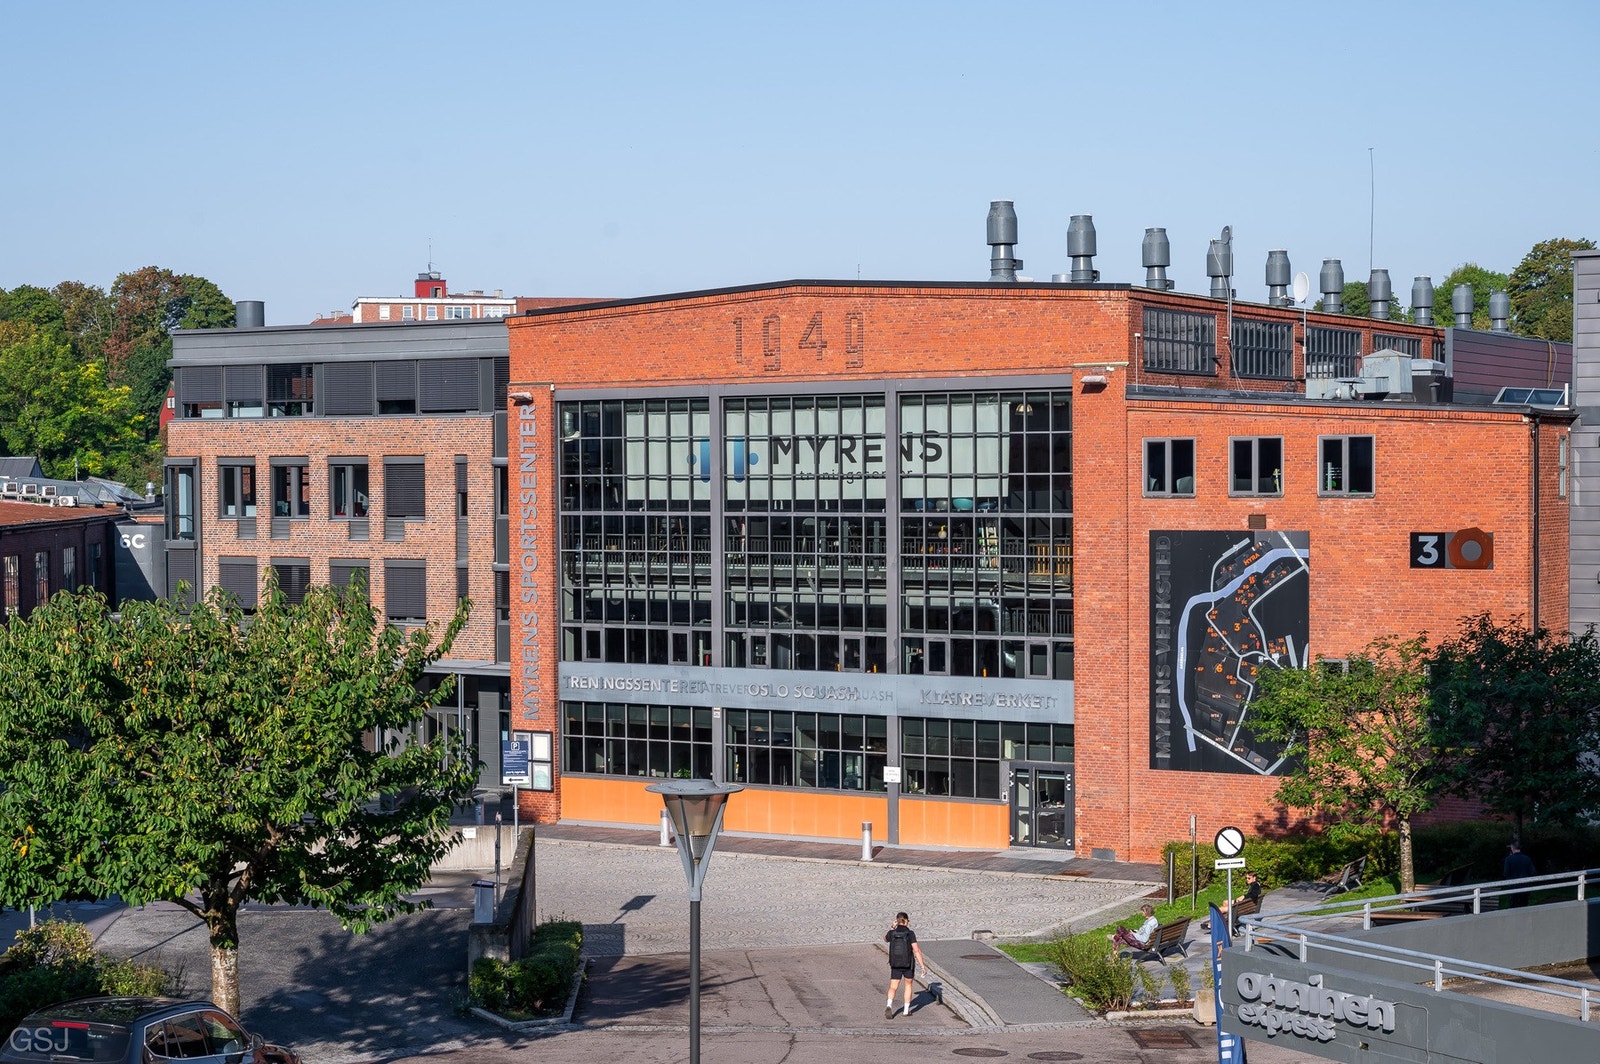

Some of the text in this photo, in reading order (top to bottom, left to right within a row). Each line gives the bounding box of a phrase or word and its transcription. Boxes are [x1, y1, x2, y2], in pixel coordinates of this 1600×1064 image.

[732, 310, 863, 371] 1949
[772, 430, 943, 465] MYRENS
[120, 533, 145, 549] 6C
[1417, 535, 1439, 565] 3
[519, 403, 540, 720] MYRENS SPORTSSENTER
[1155, 536, 1171, 759] MYRENS VERKSTED
[1215, 664, 1224, 673] 6
[1250, 667, 1257, 676] 2
[748, 683, 858, 701] OSLO SQUASH
[1237, 972, 1395, 1033] onninen
[1237, 1003, 1337, 1042] express
